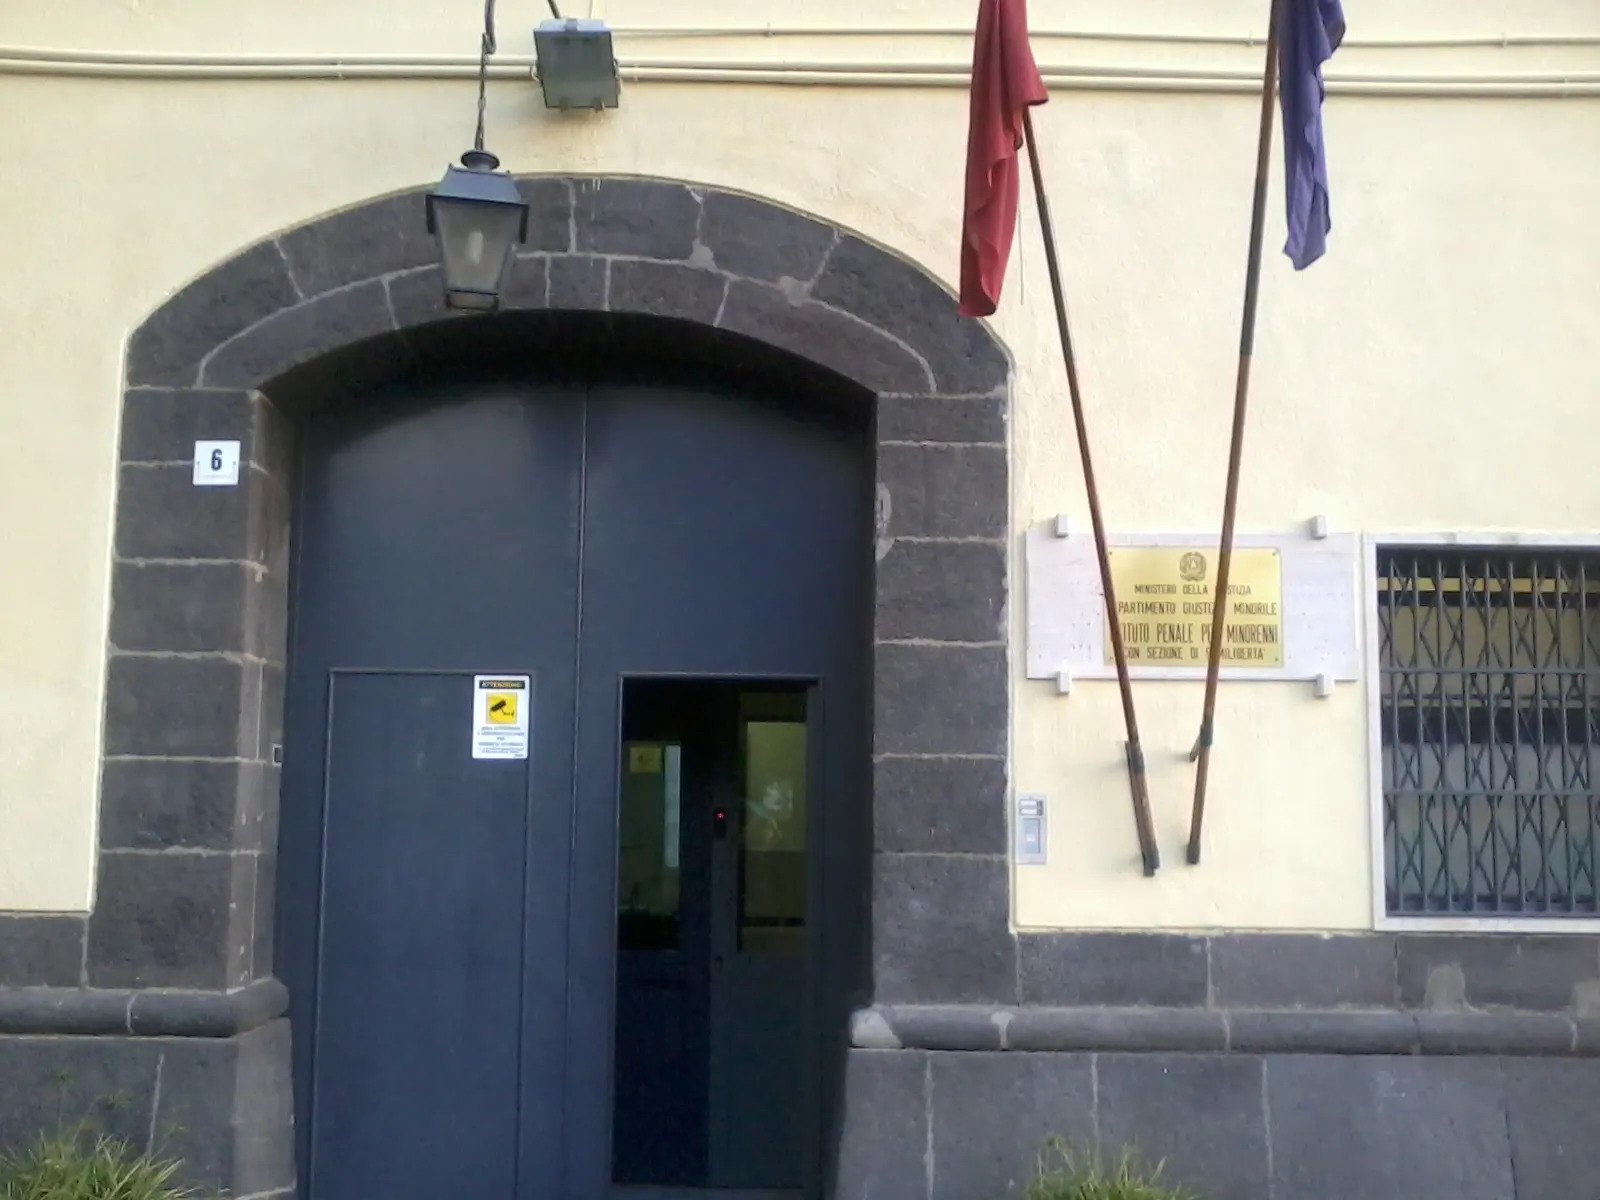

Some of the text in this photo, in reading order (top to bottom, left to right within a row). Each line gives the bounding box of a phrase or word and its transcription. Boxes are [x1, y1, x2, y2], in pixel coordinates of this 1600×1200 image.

[211, 448, 223, 471] 6
[1134, 584, 1176, 594] MINISTERO
[1183, 584, 1208, 595] DELLA
[1118, 601, 1176, 614] PARTIMENTO
[1234, 602, 1277, 616] MINORILE
[1157, 623, 1194, 643] PENALE
[1201, 623, 1213, 643] PE
[1227, 624, 1278, 644] MINORENNI
[1147, 646, 1183, 660] SEZIONE
[1190, 647, 1199, 659] DI
